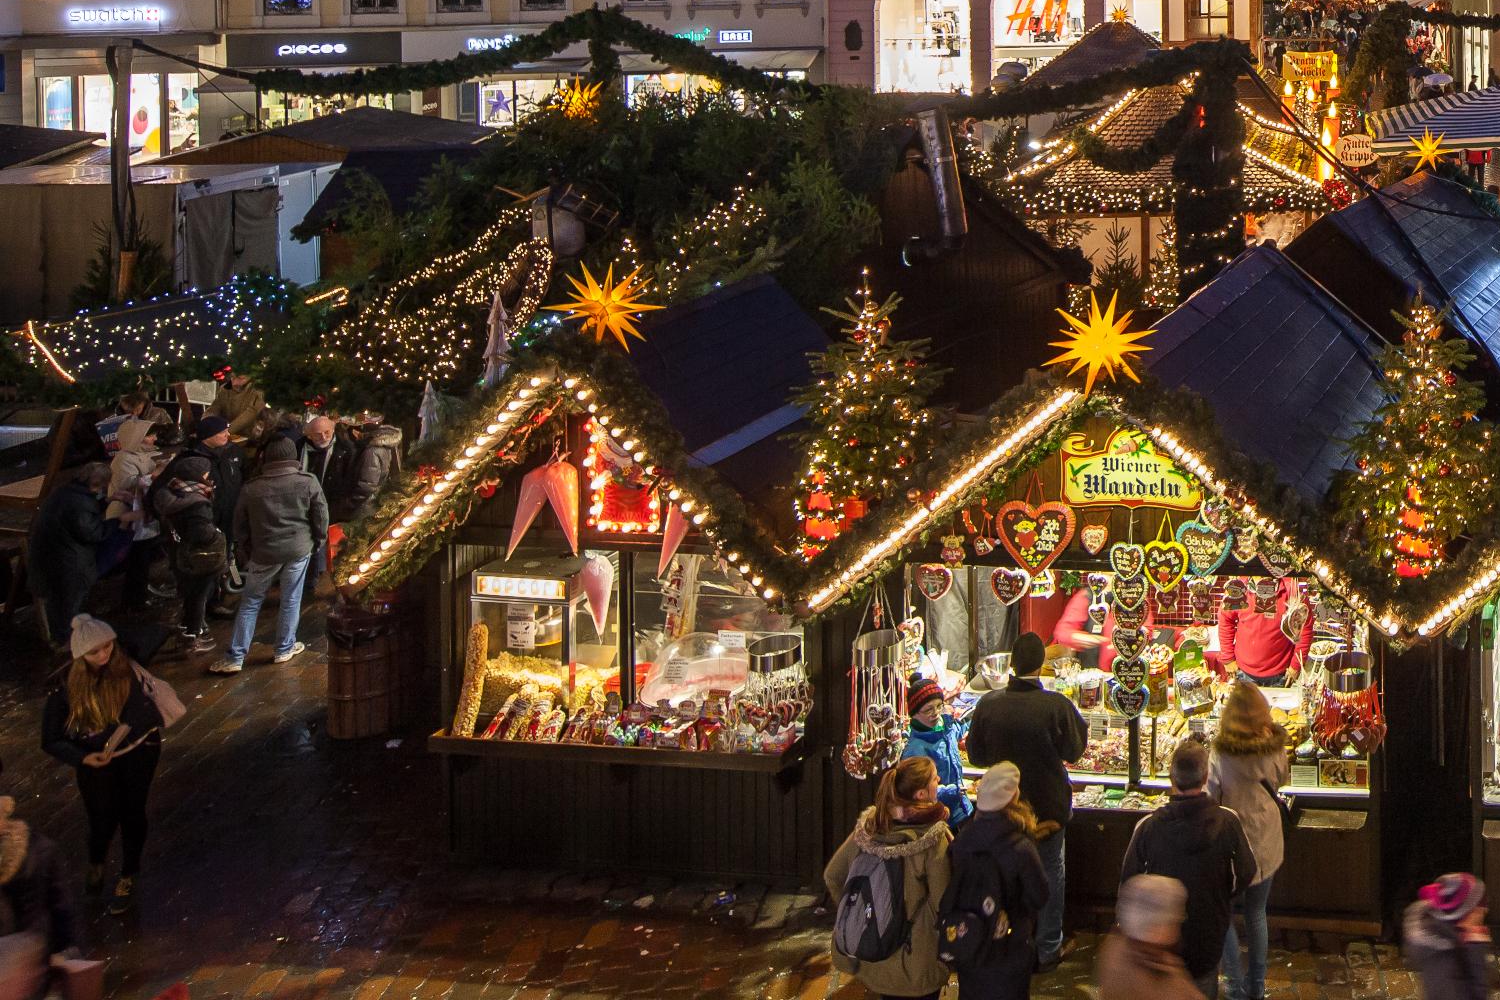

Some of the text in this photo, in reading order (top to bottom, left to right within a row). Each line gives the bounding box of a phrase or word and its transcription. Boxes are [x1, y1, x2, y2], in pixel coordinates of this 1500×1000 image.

[69, 7, 144, 22] swatch
[722, 32, 749, 41] BASE
[278, 43, 348, 57] pieces
[1344, 138, 1371, 152] Futte
[1341, 151, 1374, 163] Krippe
[1102, 457, 1160, 475] Wiener
[1083, 474, 1182, 499] Mandeln
